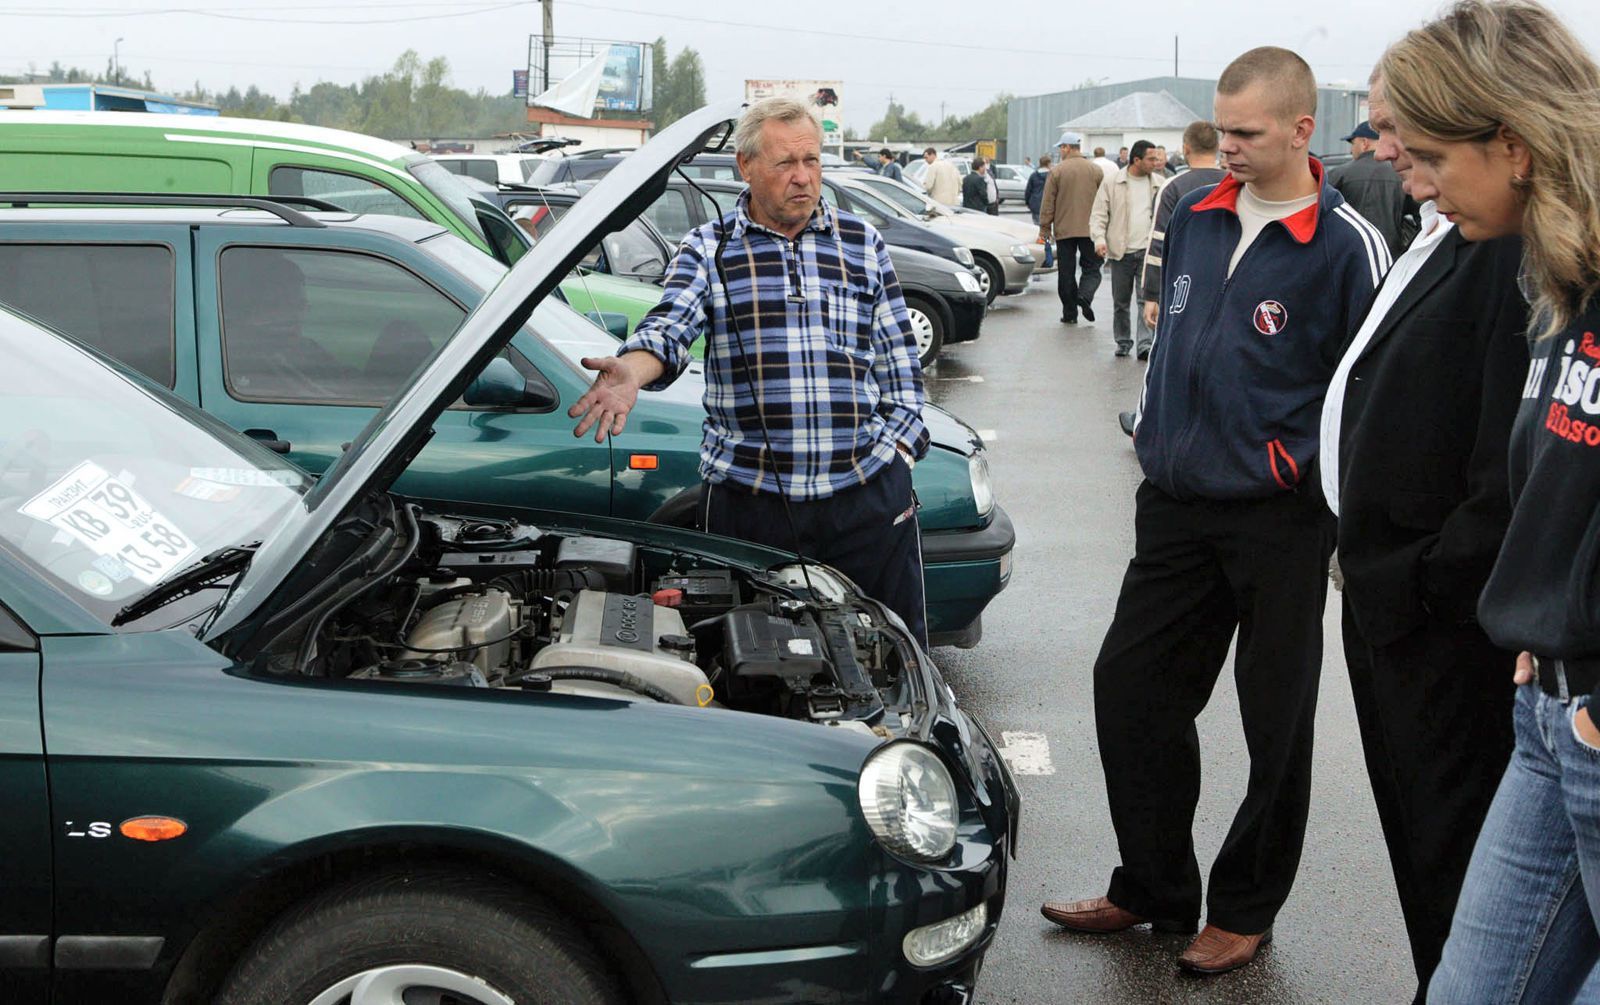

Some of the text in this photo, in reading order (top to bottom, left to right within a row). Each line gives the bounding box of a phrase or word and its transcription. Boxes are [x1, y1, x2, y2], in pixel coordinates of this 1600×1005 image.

[1169, 275, 1191, 314] 10
[91, 482, 138, 519] 39
[116, 523, 187, 575] 13 58
[65, 821, 111, 838] LS
